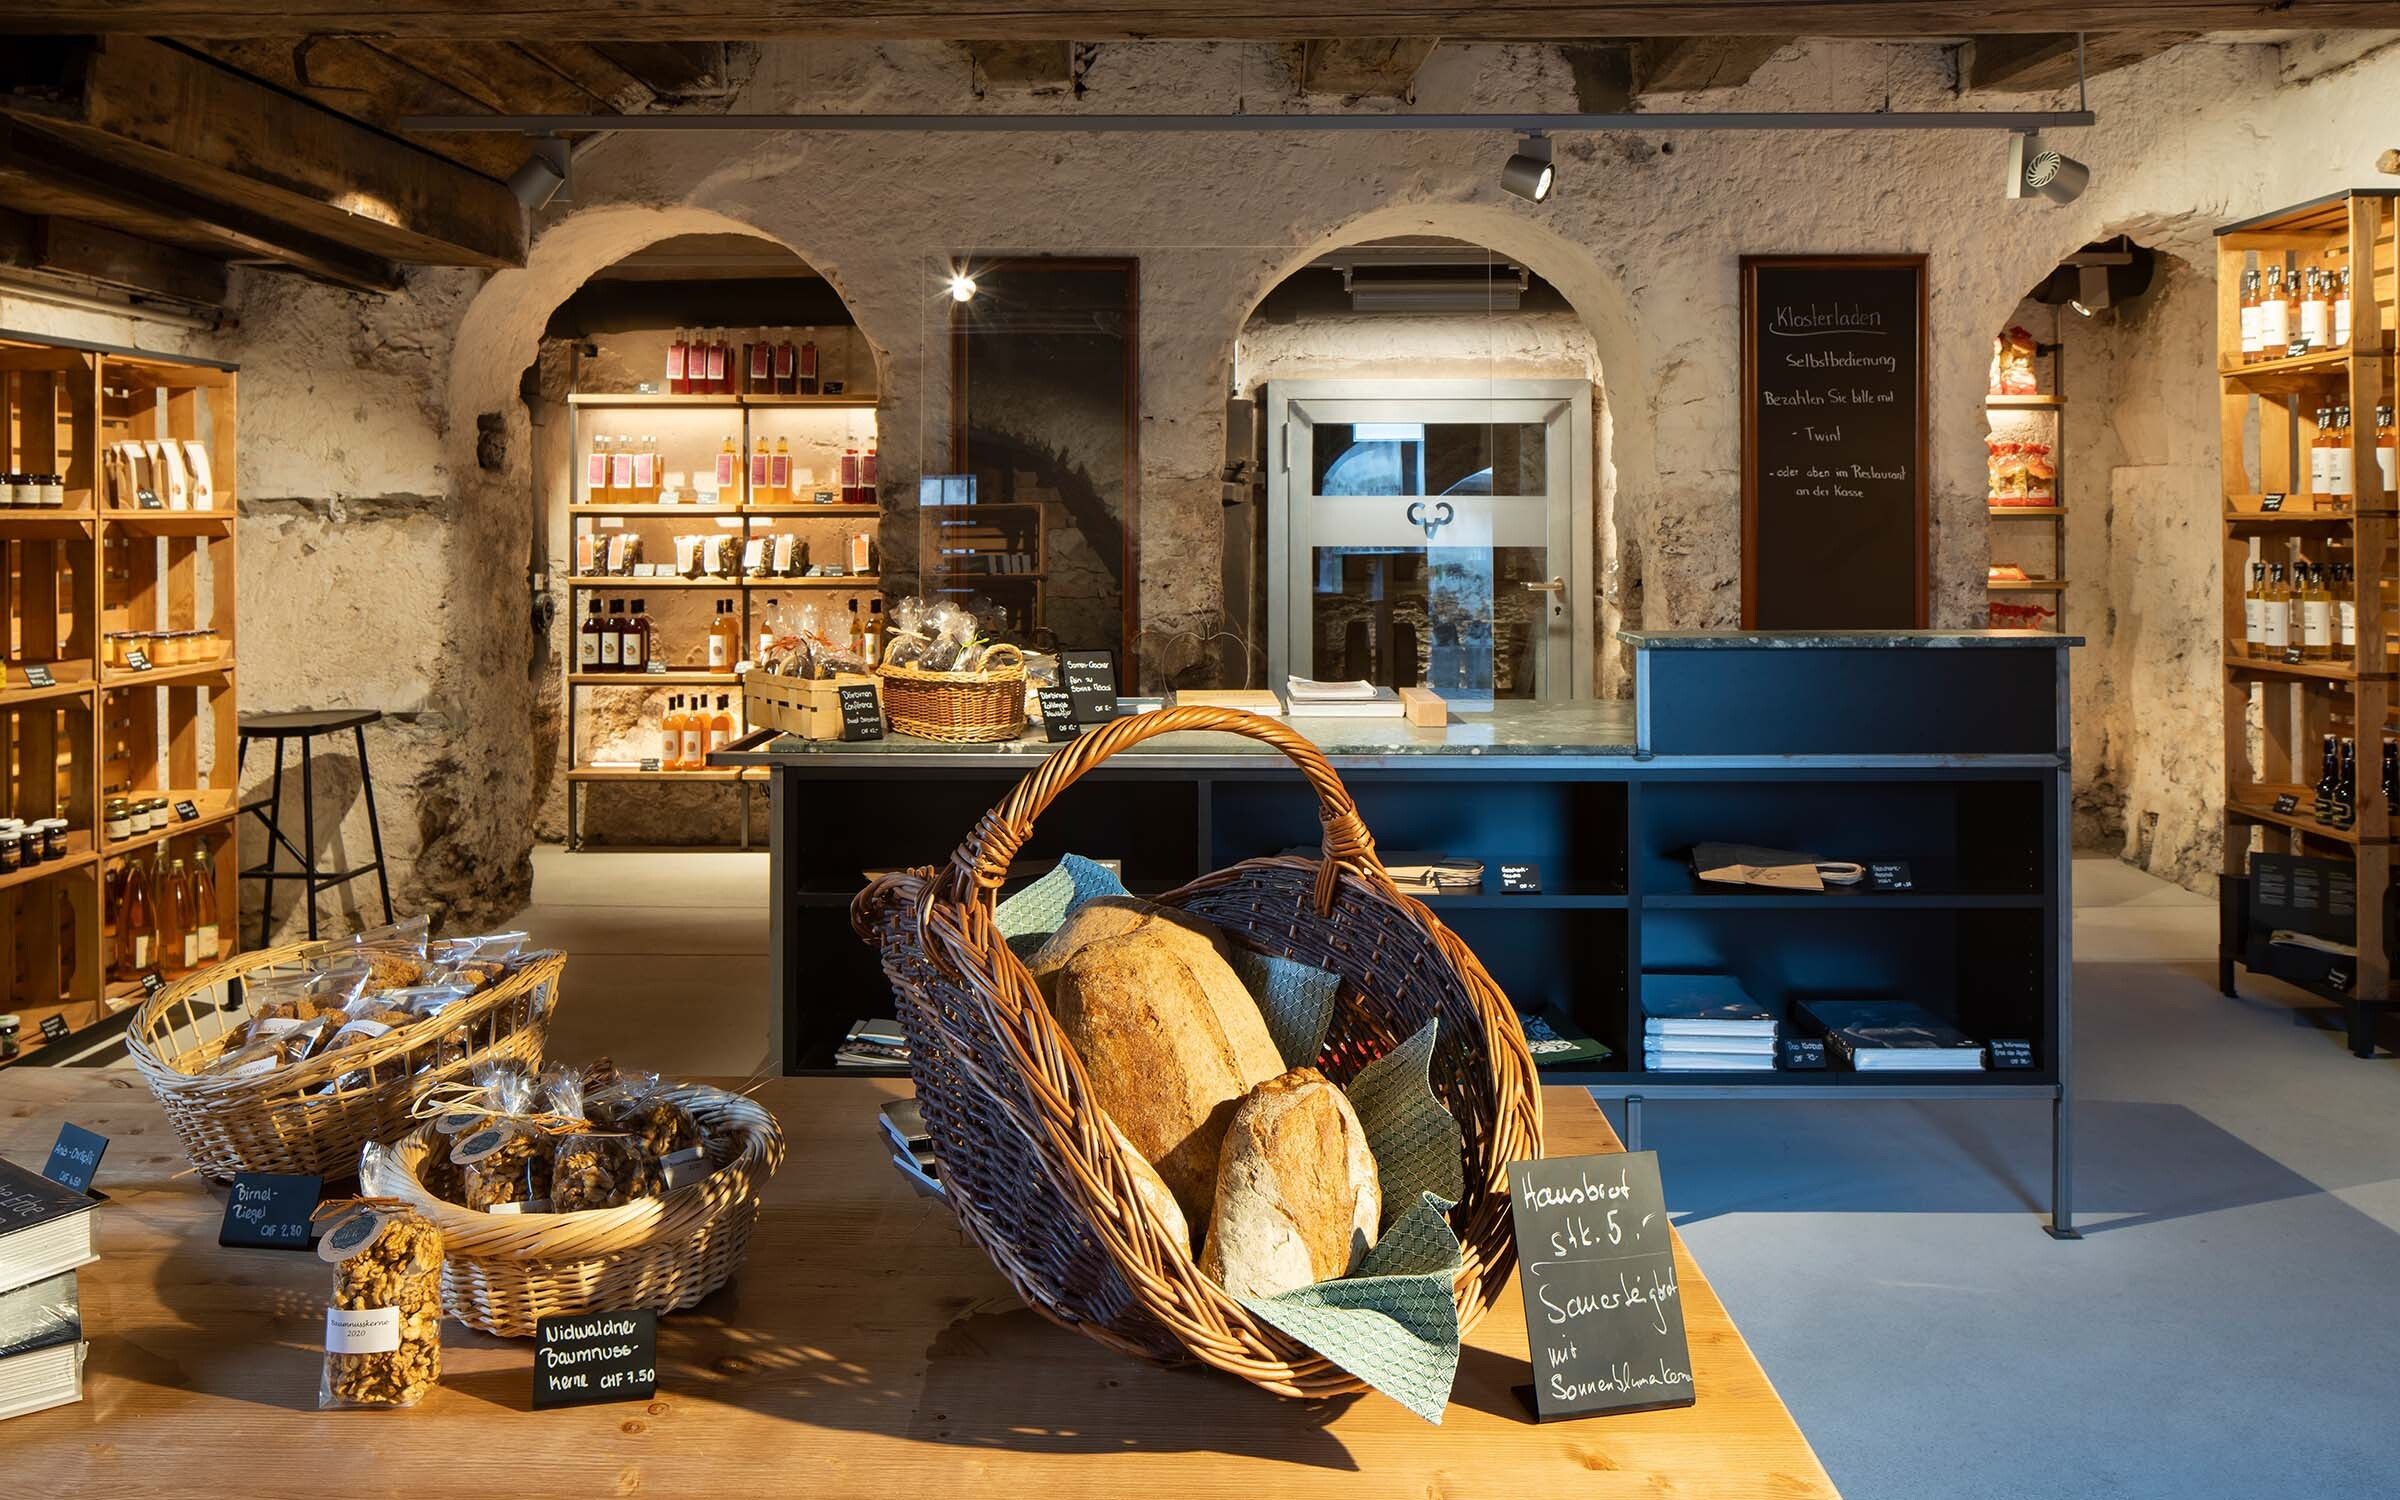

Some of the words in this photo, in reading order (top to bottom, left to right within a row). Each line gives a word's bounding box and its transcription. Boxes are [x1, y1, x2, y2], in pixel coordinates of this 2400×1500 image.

[1776, 301, 1881, 327] Klosterladen
[1785, 351, 1896, 372] Selbstbedienung
[1763, 389, 1825, 406] Bezahlen
[1827, 388, 1847, 404] Sie
[1851, 388, 1874, 404] bitte
[1877, 390, 1894, 403] mit
[1803, 425, 1841, 442] Twint
[1835, 467, 1848, 478] im
[1850, 464, 1906, 481] Restaurant
[1796, 487, 1810, 496] an
[1813, 485, 1829, 497] der
[1834, 484, 1864, 497] Kasse
[1521, 1167, 1632, 1212] Hausbrot
[232, 1204, 267, 1224] Ziegel
[330, 1319, 391, 1329] Baumnusskerne
[545, 1319, 637, 1343] Nidwaldner
[539, 1344, 640, 1369] Baumnuss-
[1547, 1334, 1578, 1368] mit
[600, 1372, 624, 1389] CHF
[627, 1368, 655, 1384] 7.50
